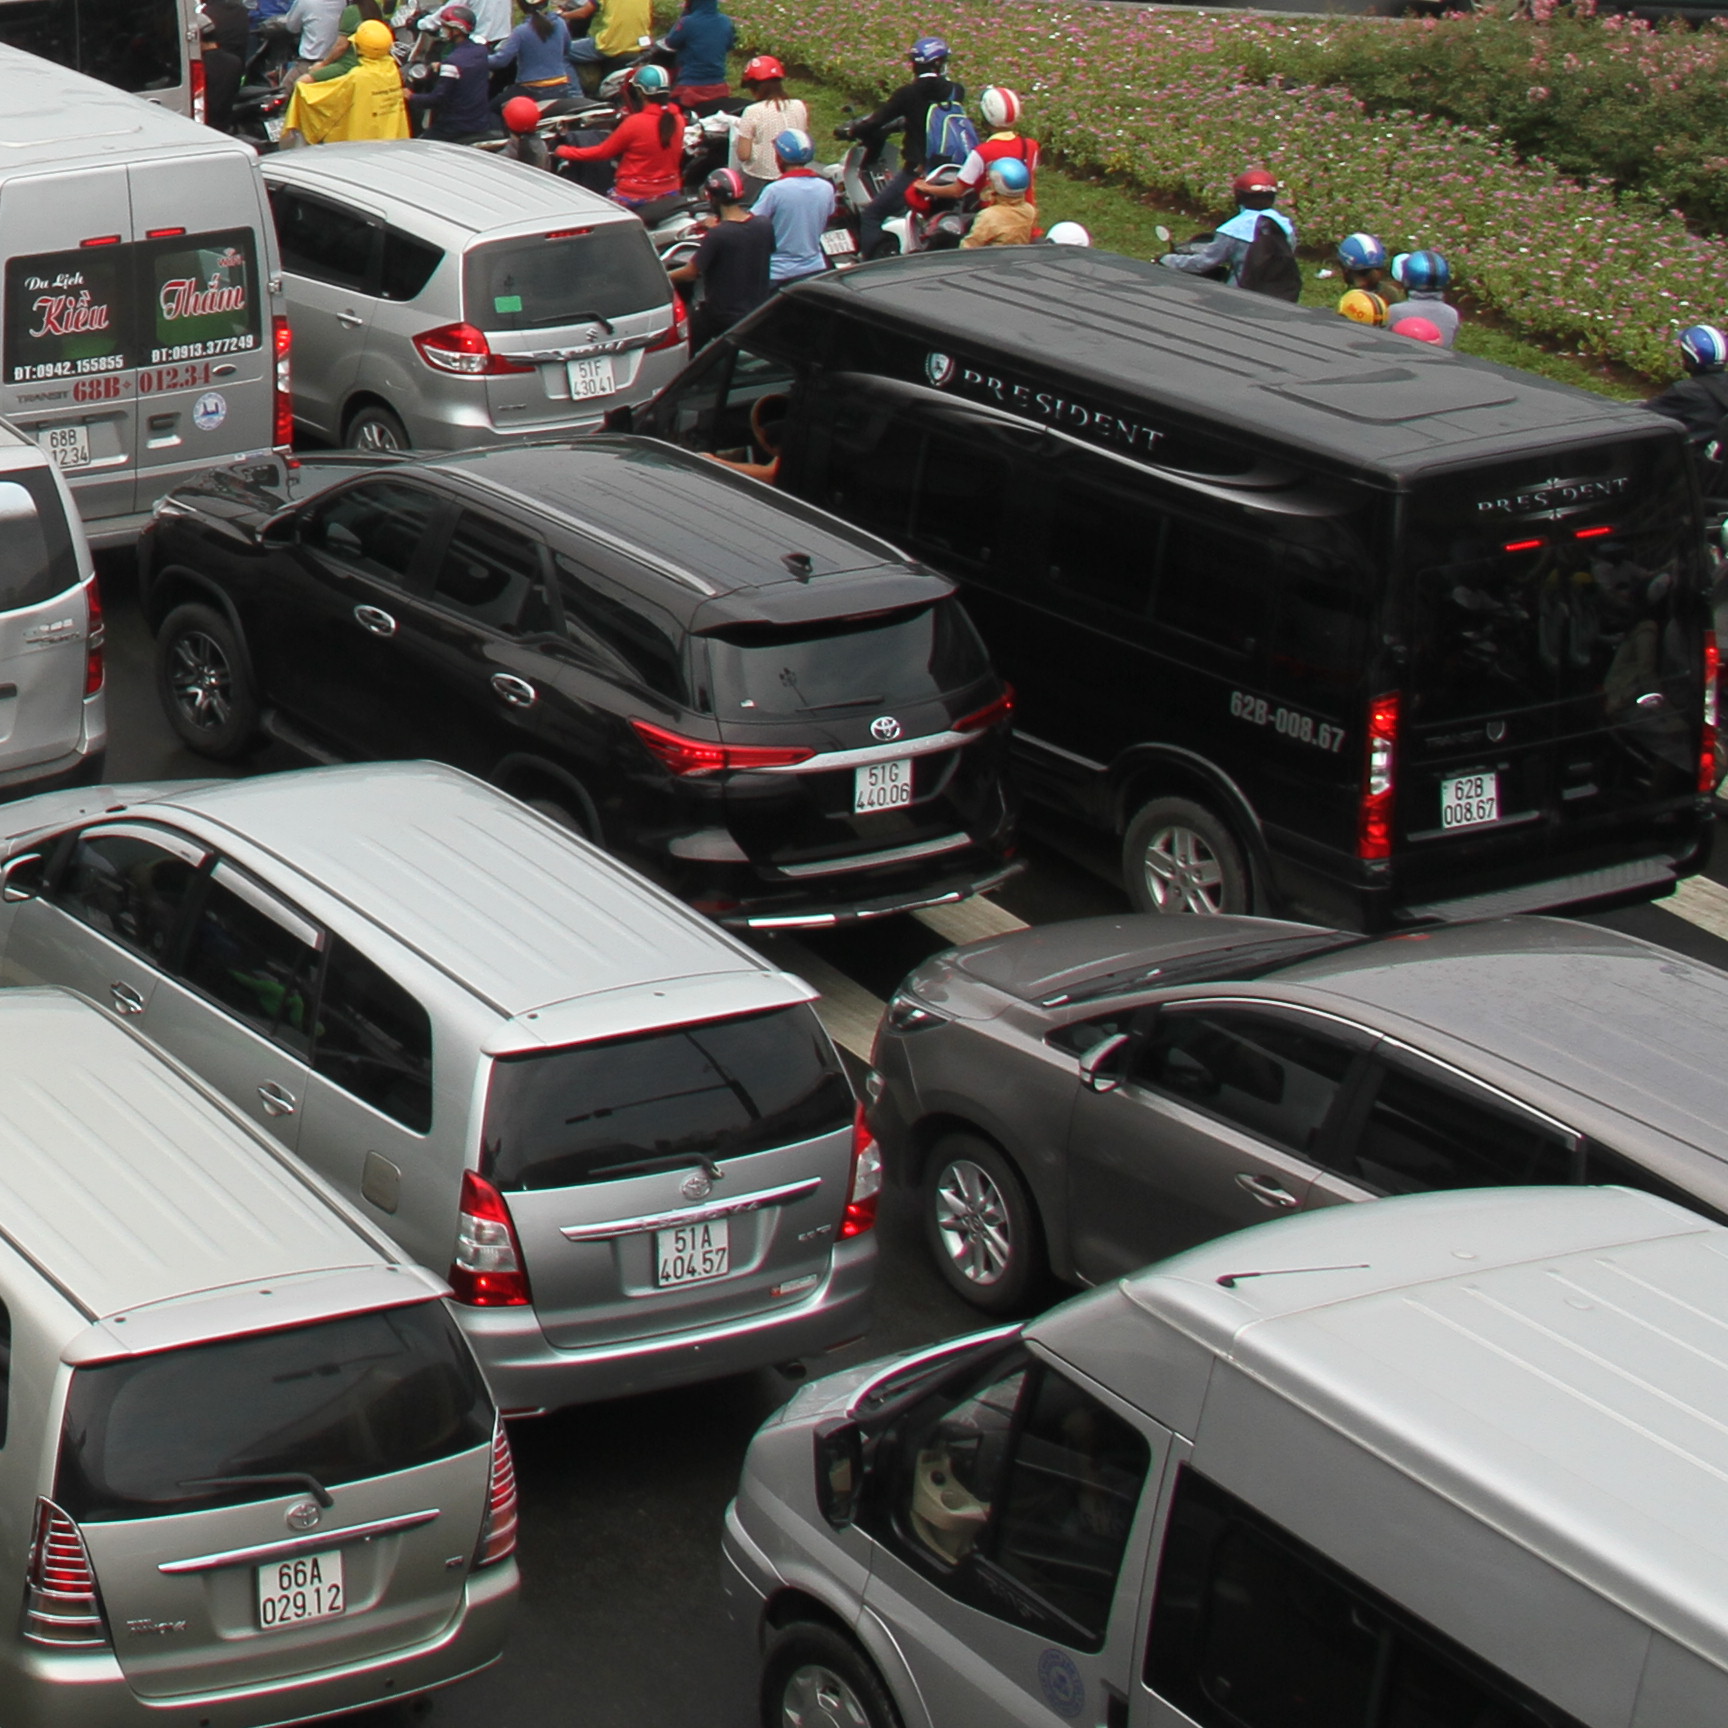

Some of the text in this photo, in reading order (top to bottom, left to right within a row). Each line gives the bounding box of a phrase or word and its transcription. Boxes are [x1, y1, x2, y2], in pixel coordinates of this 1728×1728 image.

[160, 272, 246, 320] Thắm
[28, 289, 109, 338] Kiều
[151, 335, 255, 362] ĐT:0913.377249
[13, 355, 124, 380] ĐT:0942.155855
[578, 359, 601, 379] 51F
[73, 364, 212, 402] 68B 012.34
[574, 375, 614, 397] 430.41
[964, 368, 1166, 452] PRESIDENT
[49, 428, 78, 449] 68B
[1230, 691, 1346, 753] 62B-008.67
[868, 762, 899, 787] 51G
[1454, 776, 1484, 800] 62B
[856, 782, 911, 810] 440.06
[1443, 797, 1495, 826] 008.67
[673, 1221, 714, 1253] 51A
[659, 1246, 728, 1283] 404.57
[278, 1556, 323, 1591] 66A
[262, 1582, 342, 1625] 029.12
